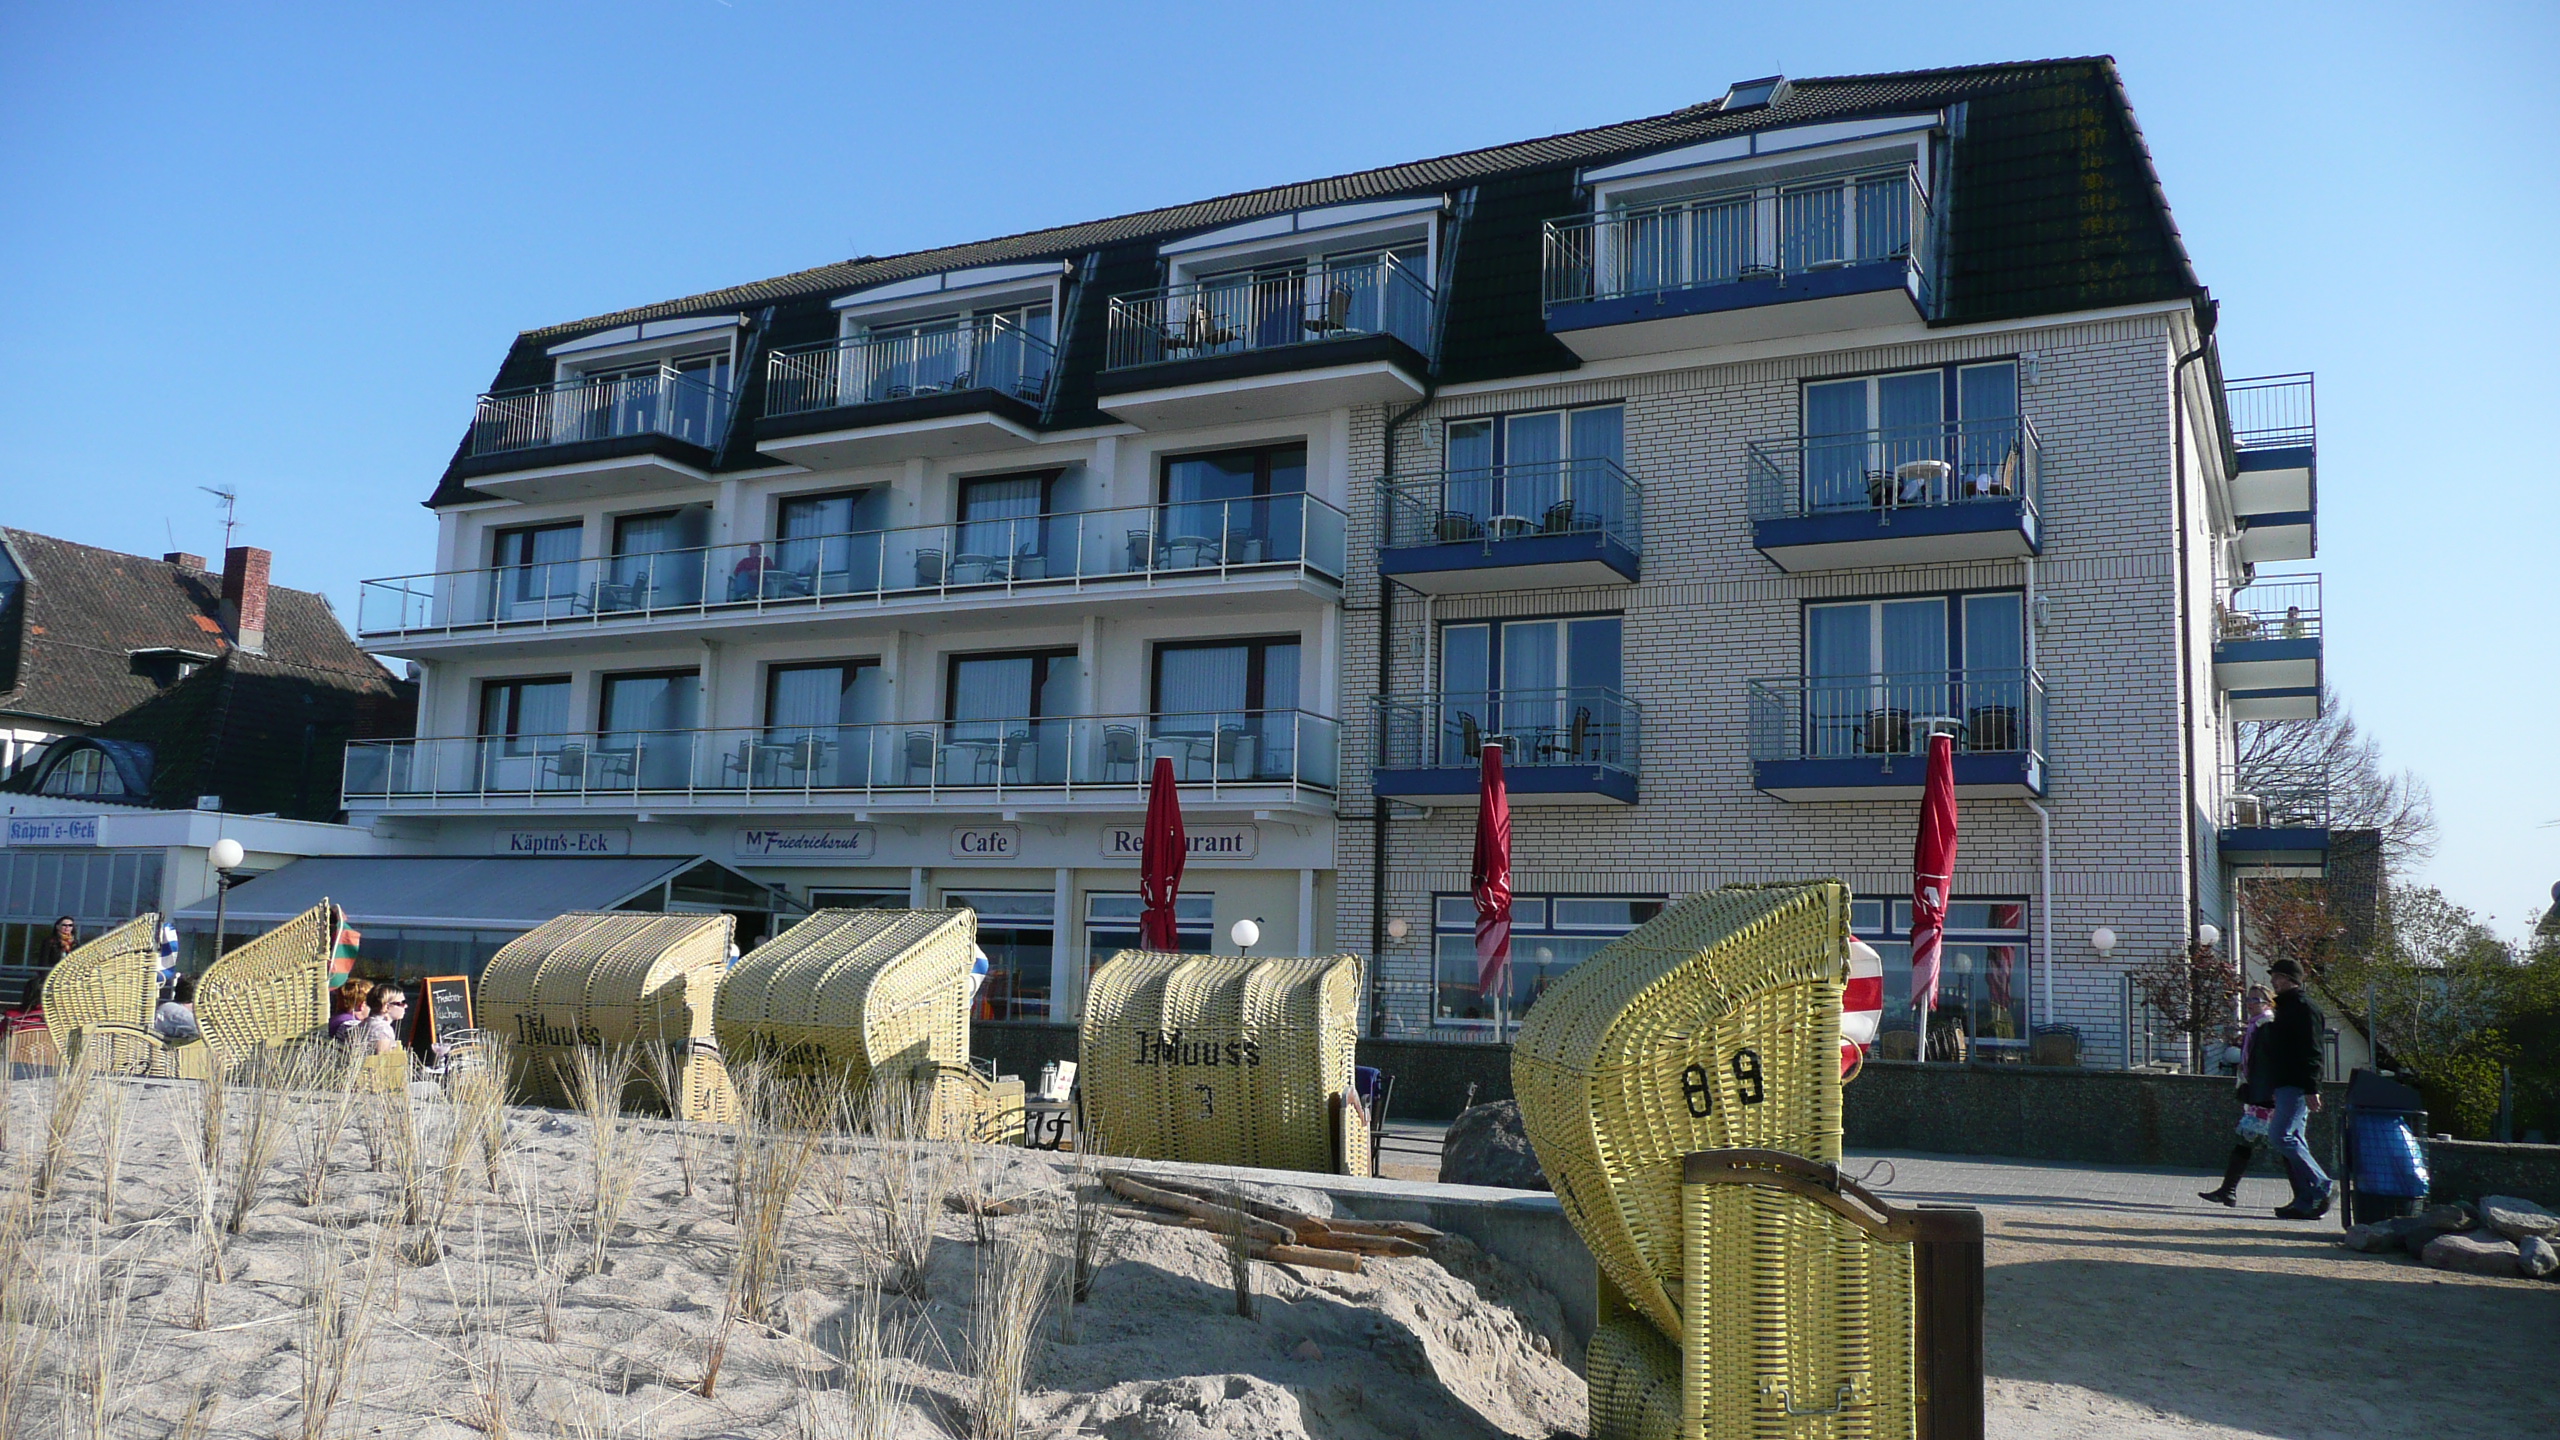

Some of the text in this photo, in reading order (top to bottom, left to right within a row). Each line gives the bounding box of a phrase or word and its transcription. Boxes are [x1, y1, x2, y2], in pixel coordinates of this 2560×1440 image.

[511, 833, 608, 855] Käptn's-Eck
[764, 831, 859, 854] Friedrichsruh
[961, 832, 1008, 852] Cafe
[1115, 831, 1244, 852] Reurant
